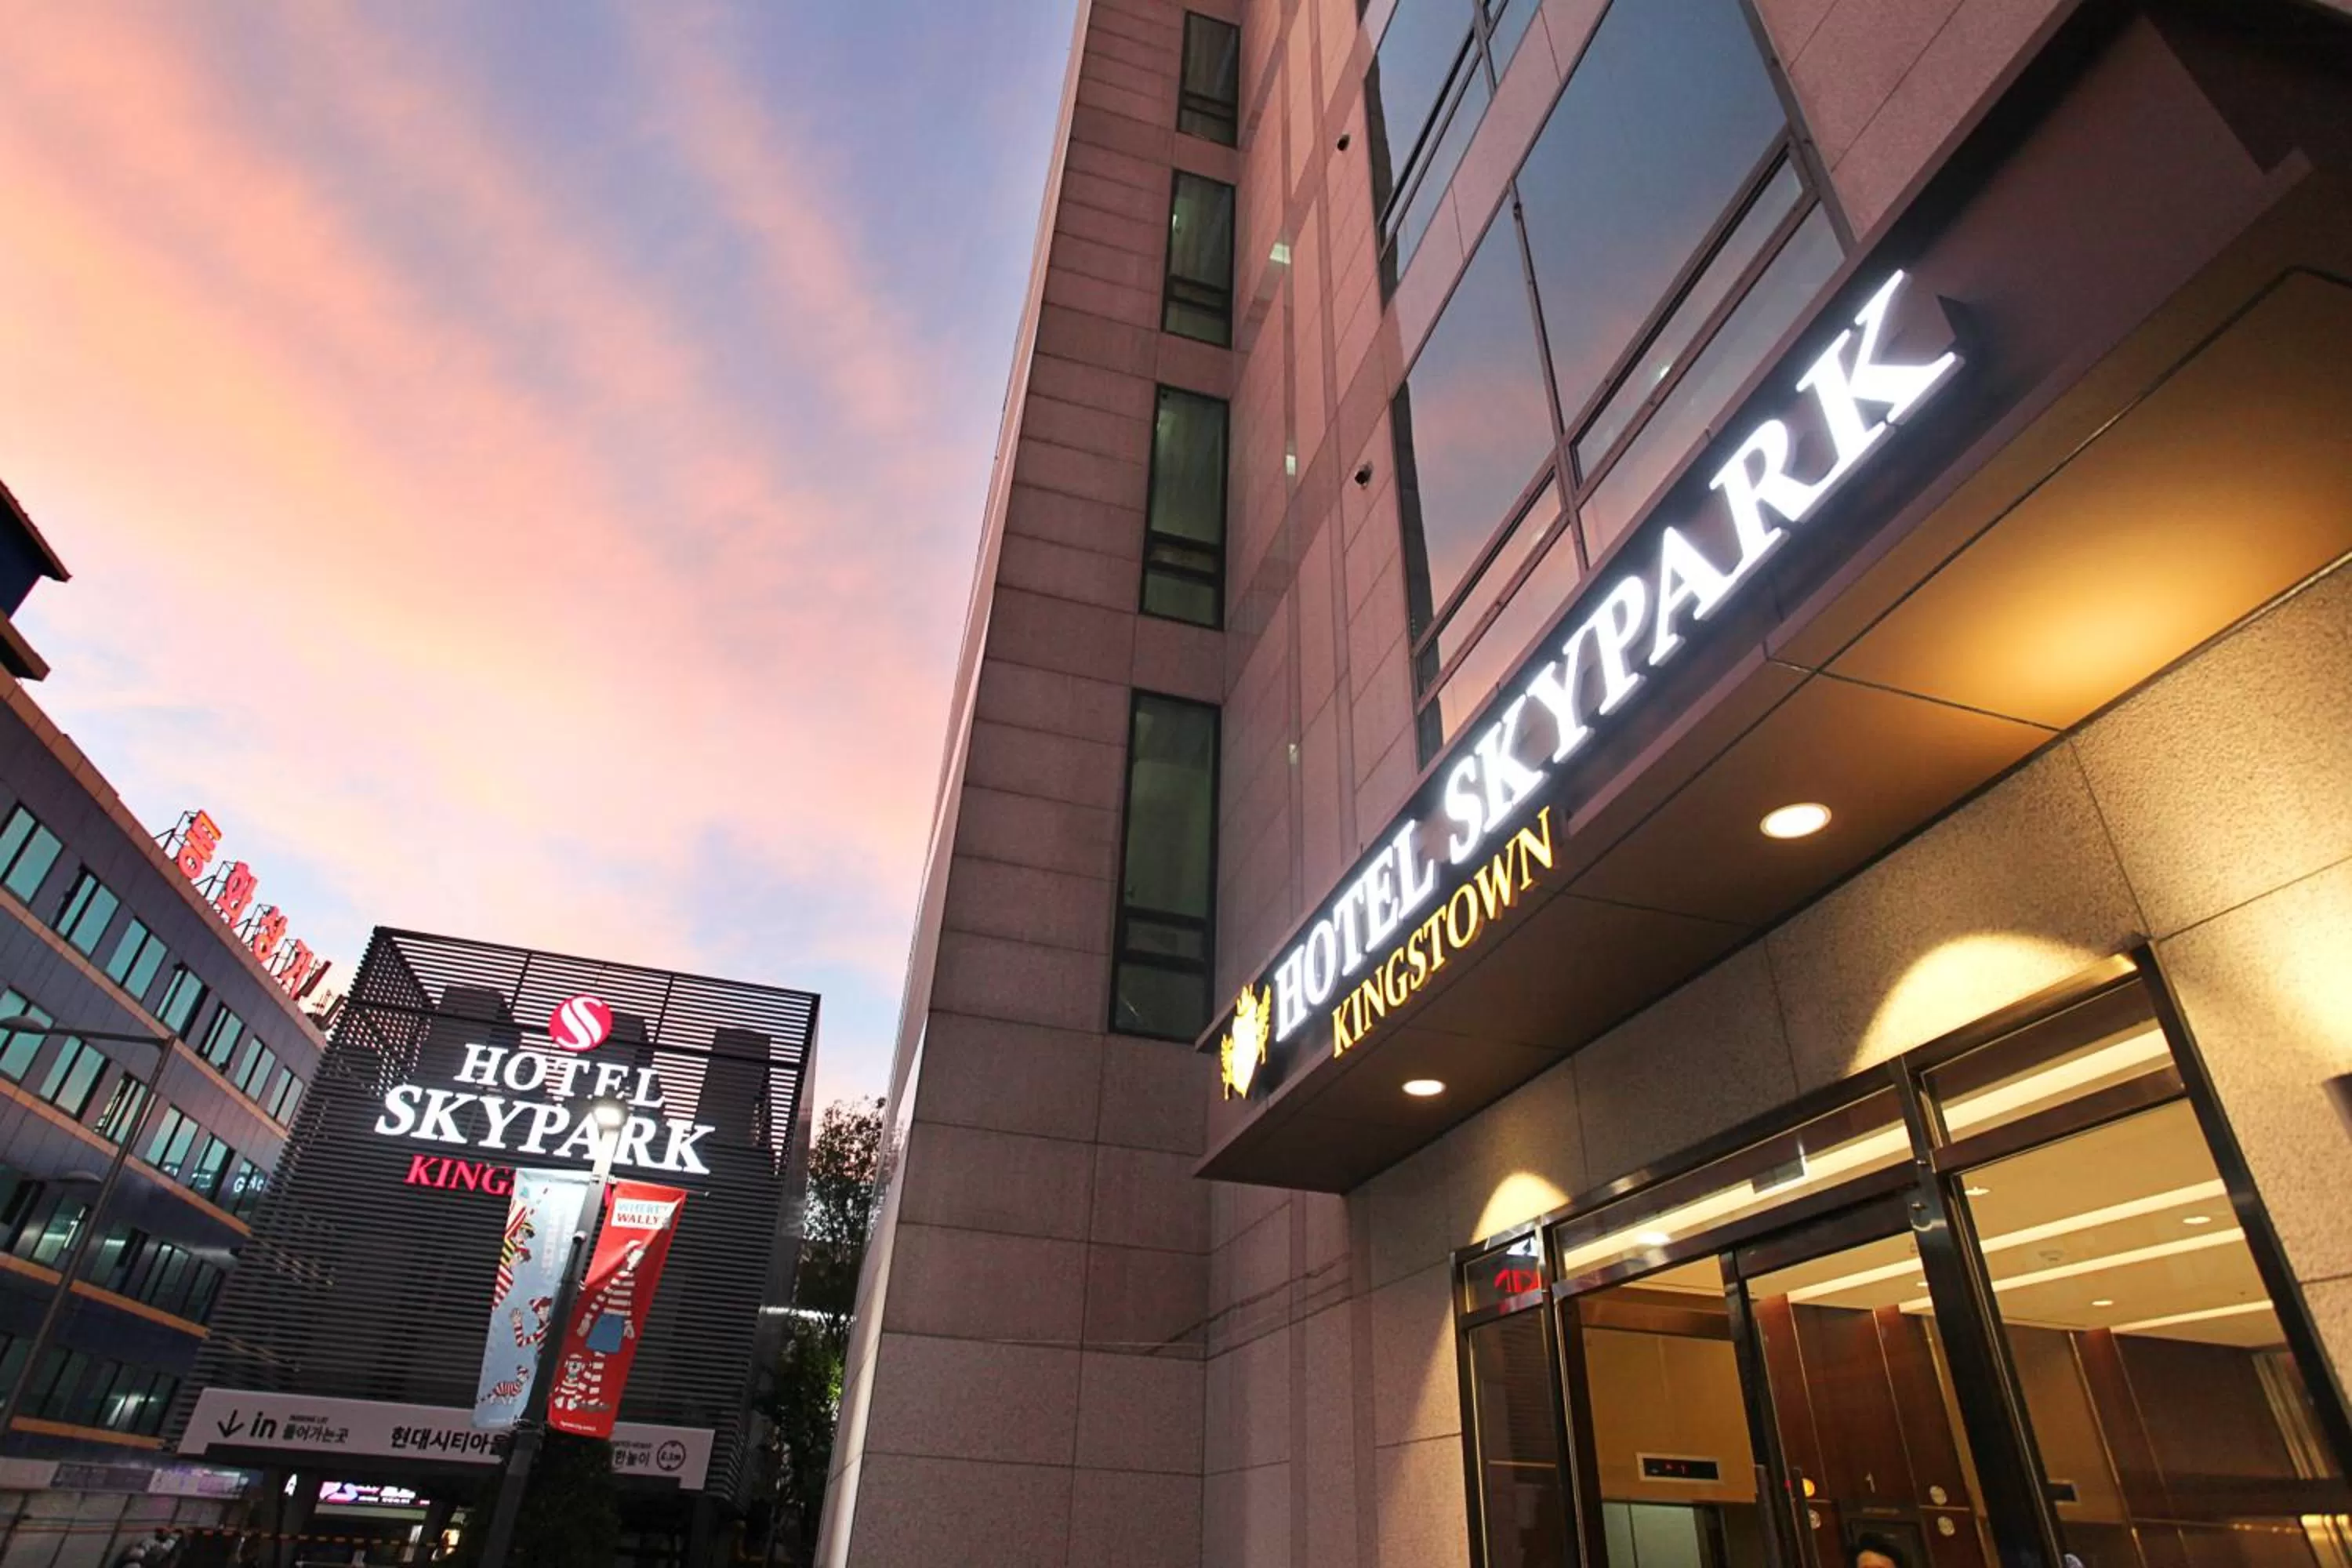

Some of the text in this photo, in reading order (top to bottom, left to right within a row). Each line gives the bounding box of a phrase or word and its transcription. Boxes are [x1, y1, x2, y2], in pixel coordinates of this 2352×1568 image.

[1274, 269, 1958, 1042] HOTEL SKYPARK
[1333, 806, 1553, 1058] KINGSTOWN
[452, 1042, 666, 1109] HOTEL
[374, 1083, 716, 1175] SKYPARK
[403, 1153, 514, 1196] KING
[617, 1213, 660, 1225] WALLY
[249, 1410, 278, 1439] in
